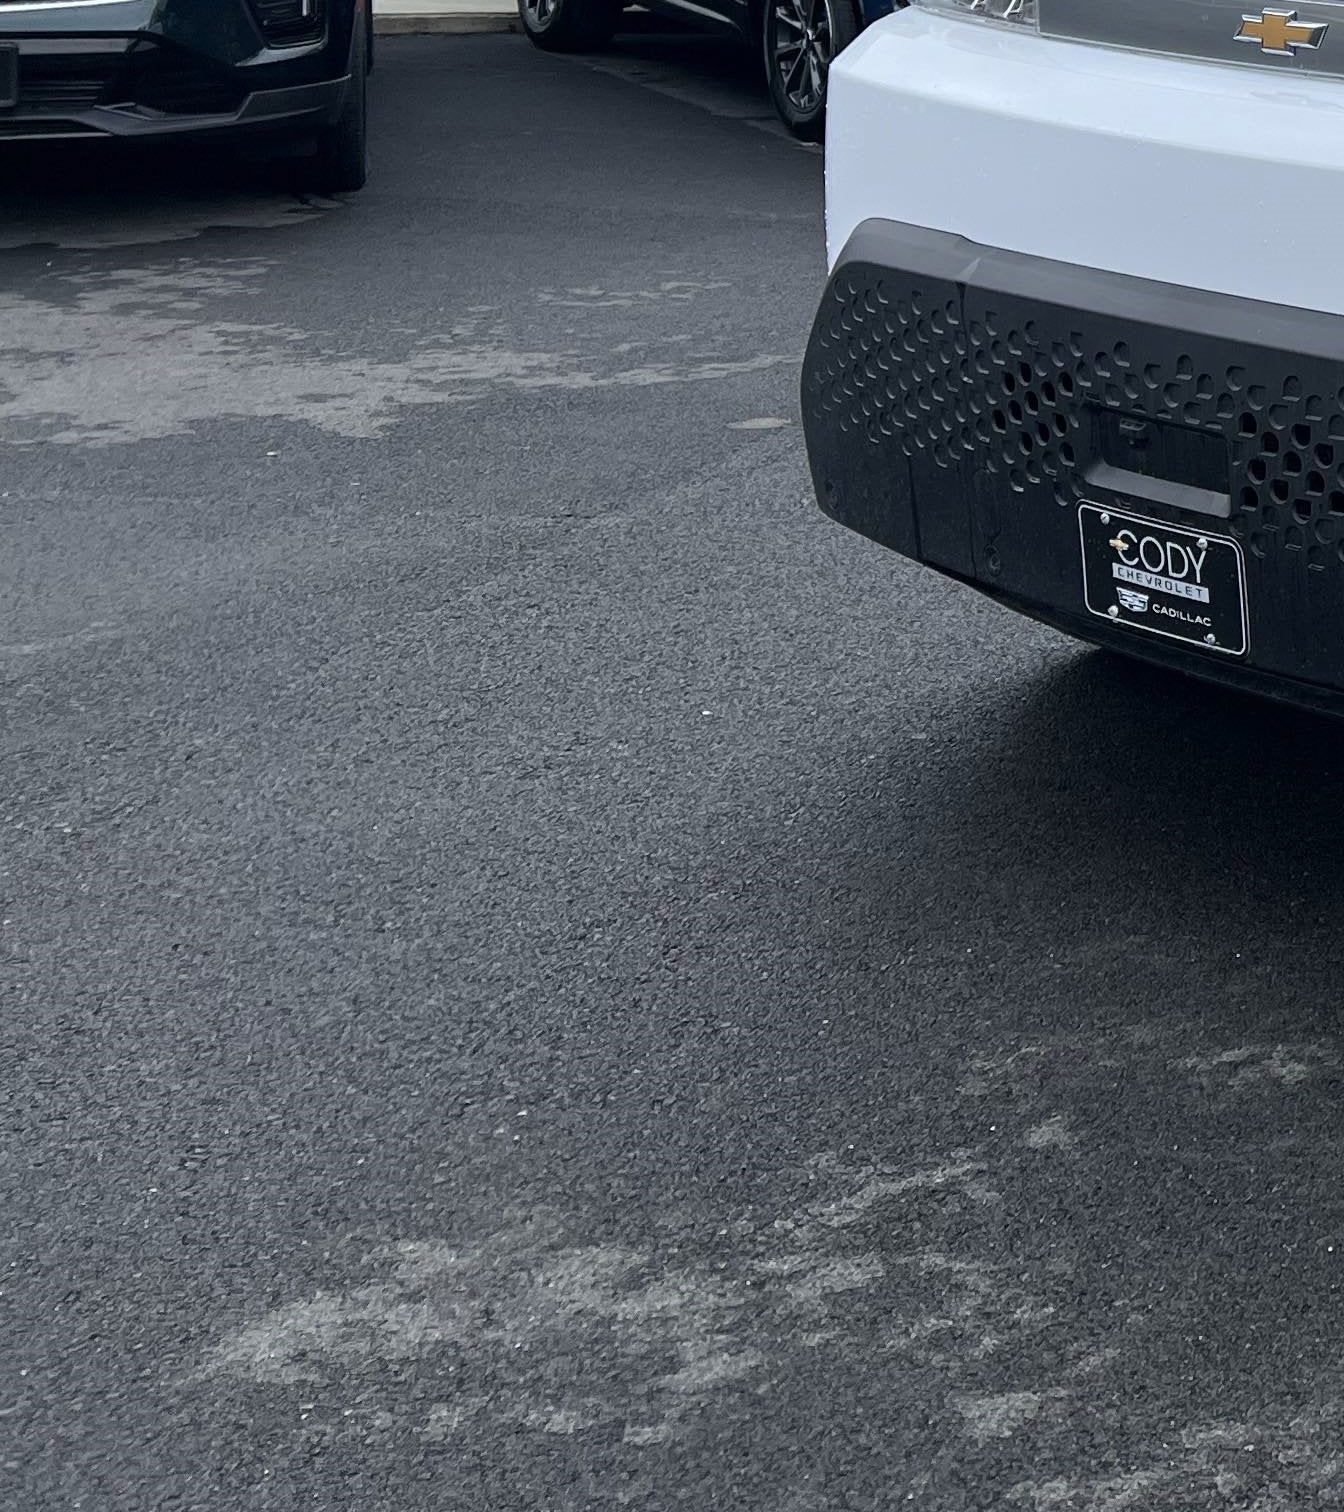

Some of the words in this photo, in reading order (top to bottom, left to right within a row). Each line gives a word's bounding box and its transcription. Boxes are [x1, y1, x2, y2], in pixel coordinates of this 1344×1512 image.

[1116, 529, 1207, 584] CODY
[1117, 566, 1204, 599] CHEVROLET
[1152, 603, 1212, 627] CADILLAC
